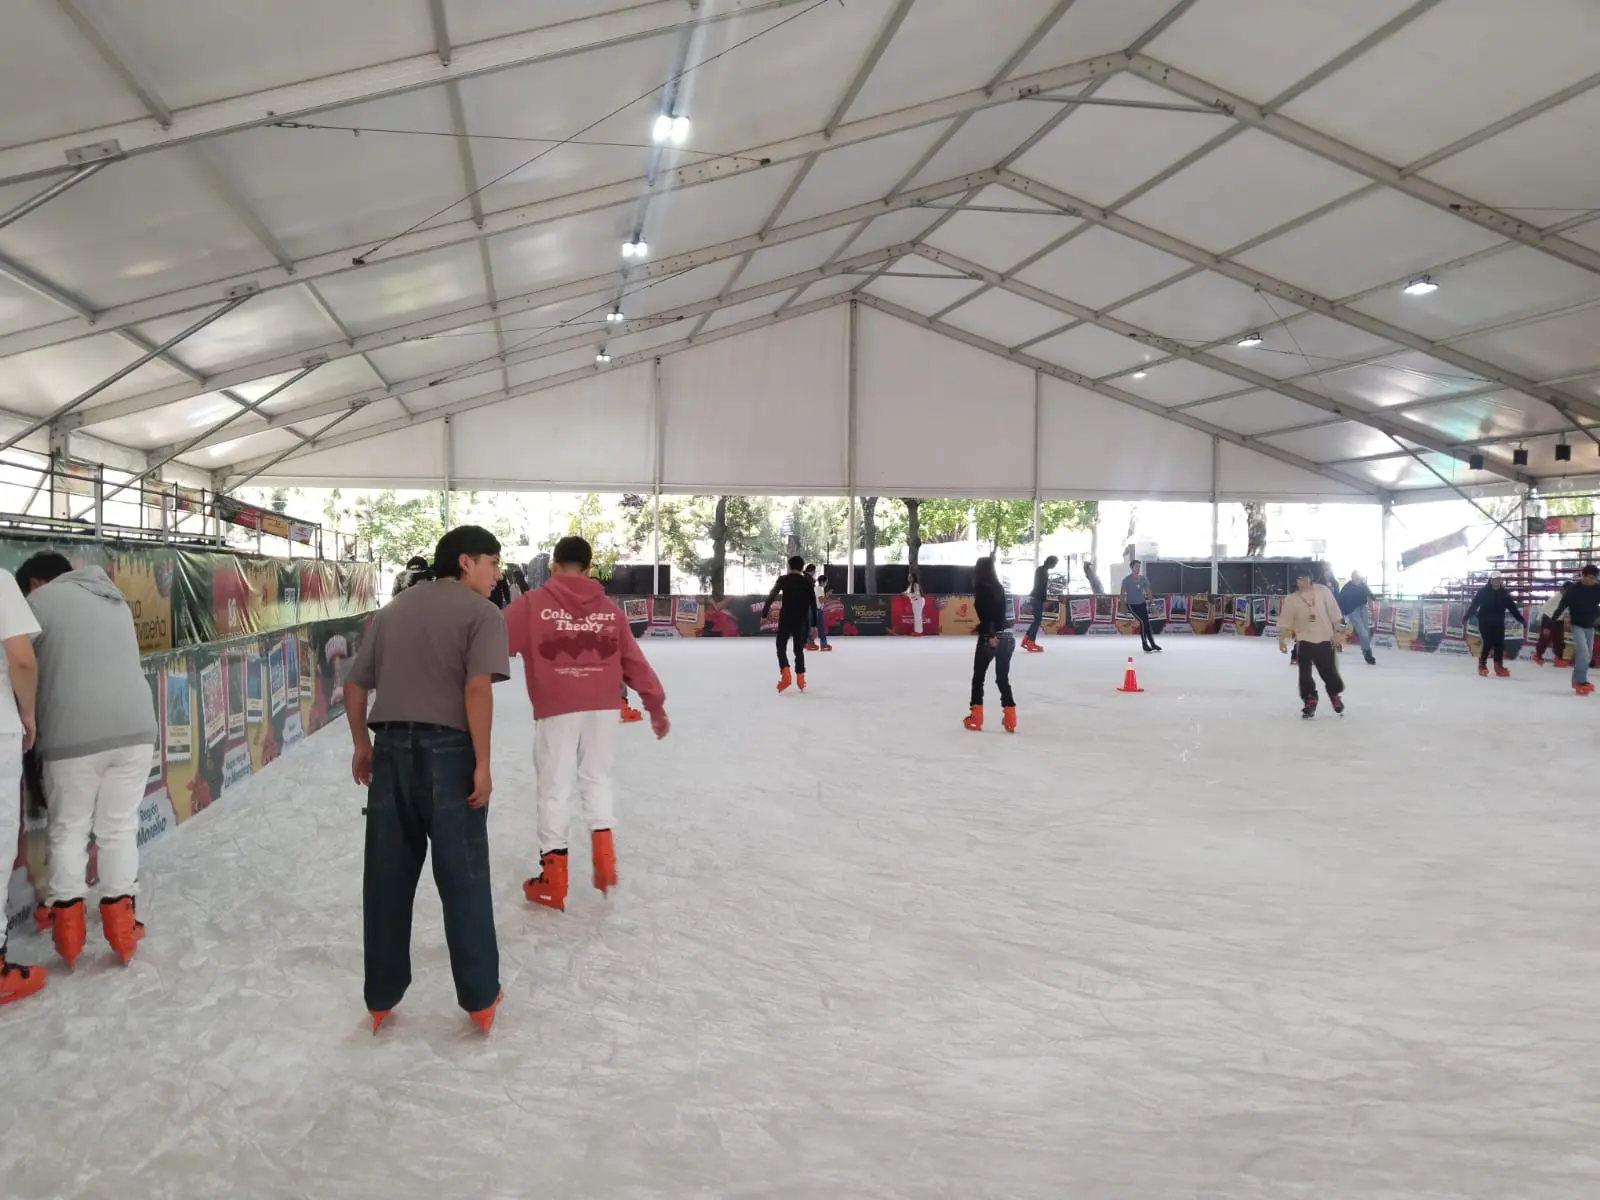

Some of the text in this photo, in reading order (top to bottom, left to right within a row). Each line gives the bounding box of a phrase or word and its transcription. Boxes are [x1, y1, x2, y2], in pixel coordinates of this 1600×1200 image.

[577, 612, 617, 622] eart
[556, 620, 604, 634] Theory
[136, 815, 167, 849] Morelia
